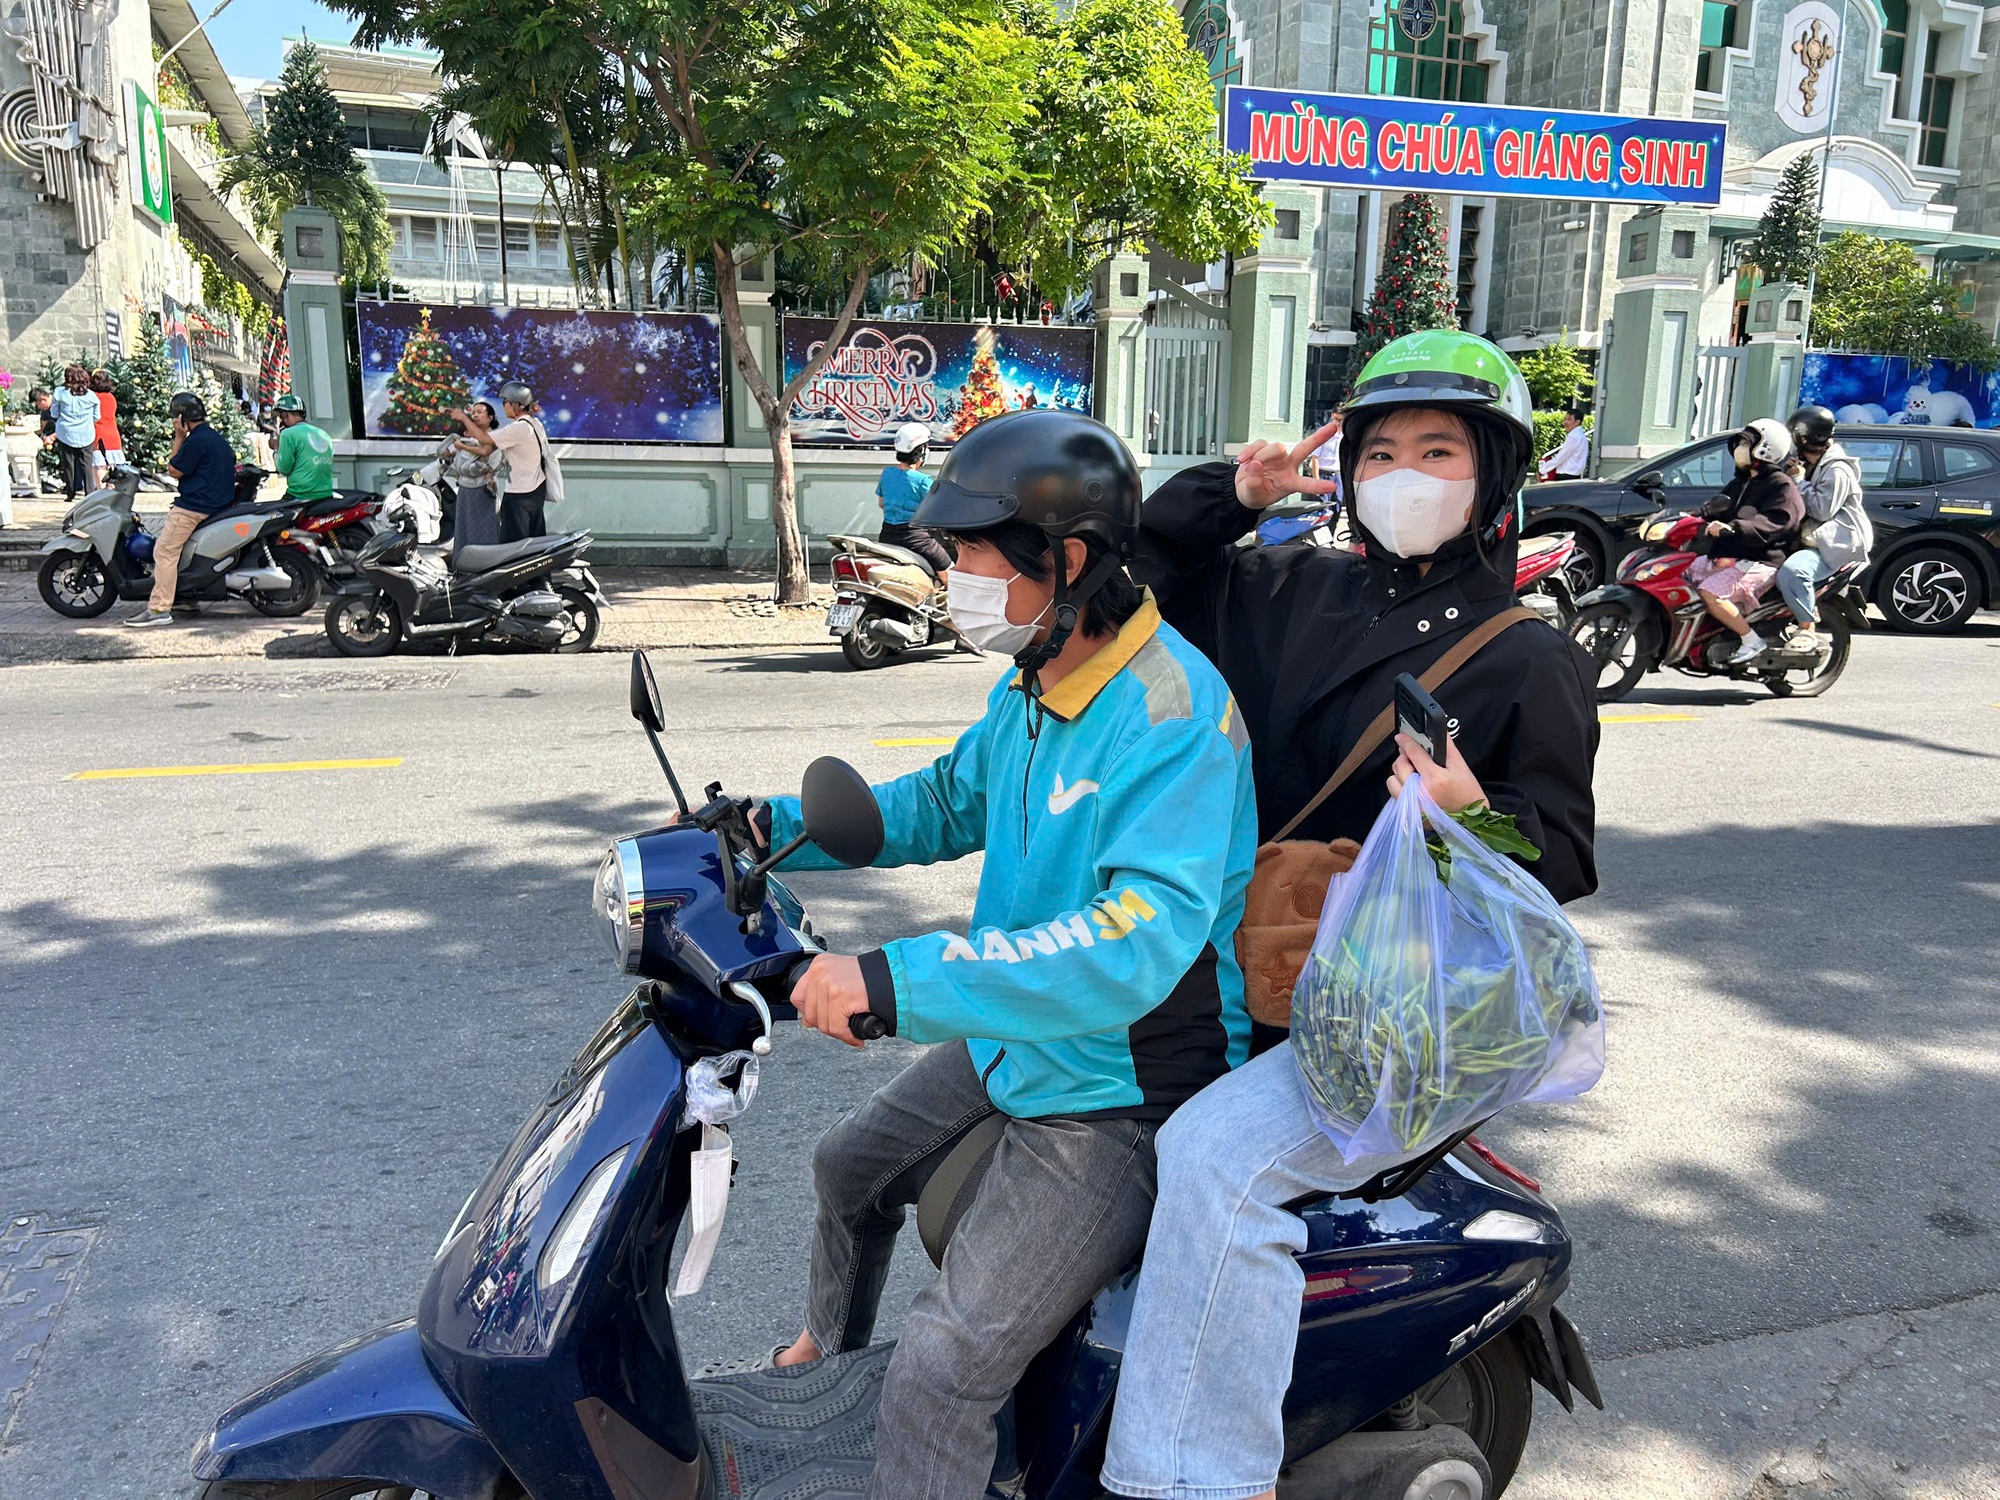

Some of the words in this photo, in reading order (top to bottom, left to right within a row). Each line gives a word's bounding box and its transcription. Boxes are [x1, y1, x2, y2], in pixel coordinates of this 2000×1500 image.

[1250, 100, 1369, 168] MỪNG
[1377, 112, 1484, 176] CHÚA
[1493, 117, 1613, 183] GIÁNG
[1619, 136, 1709, 188] SINH
[941, 913, 1095, 964] XANH
